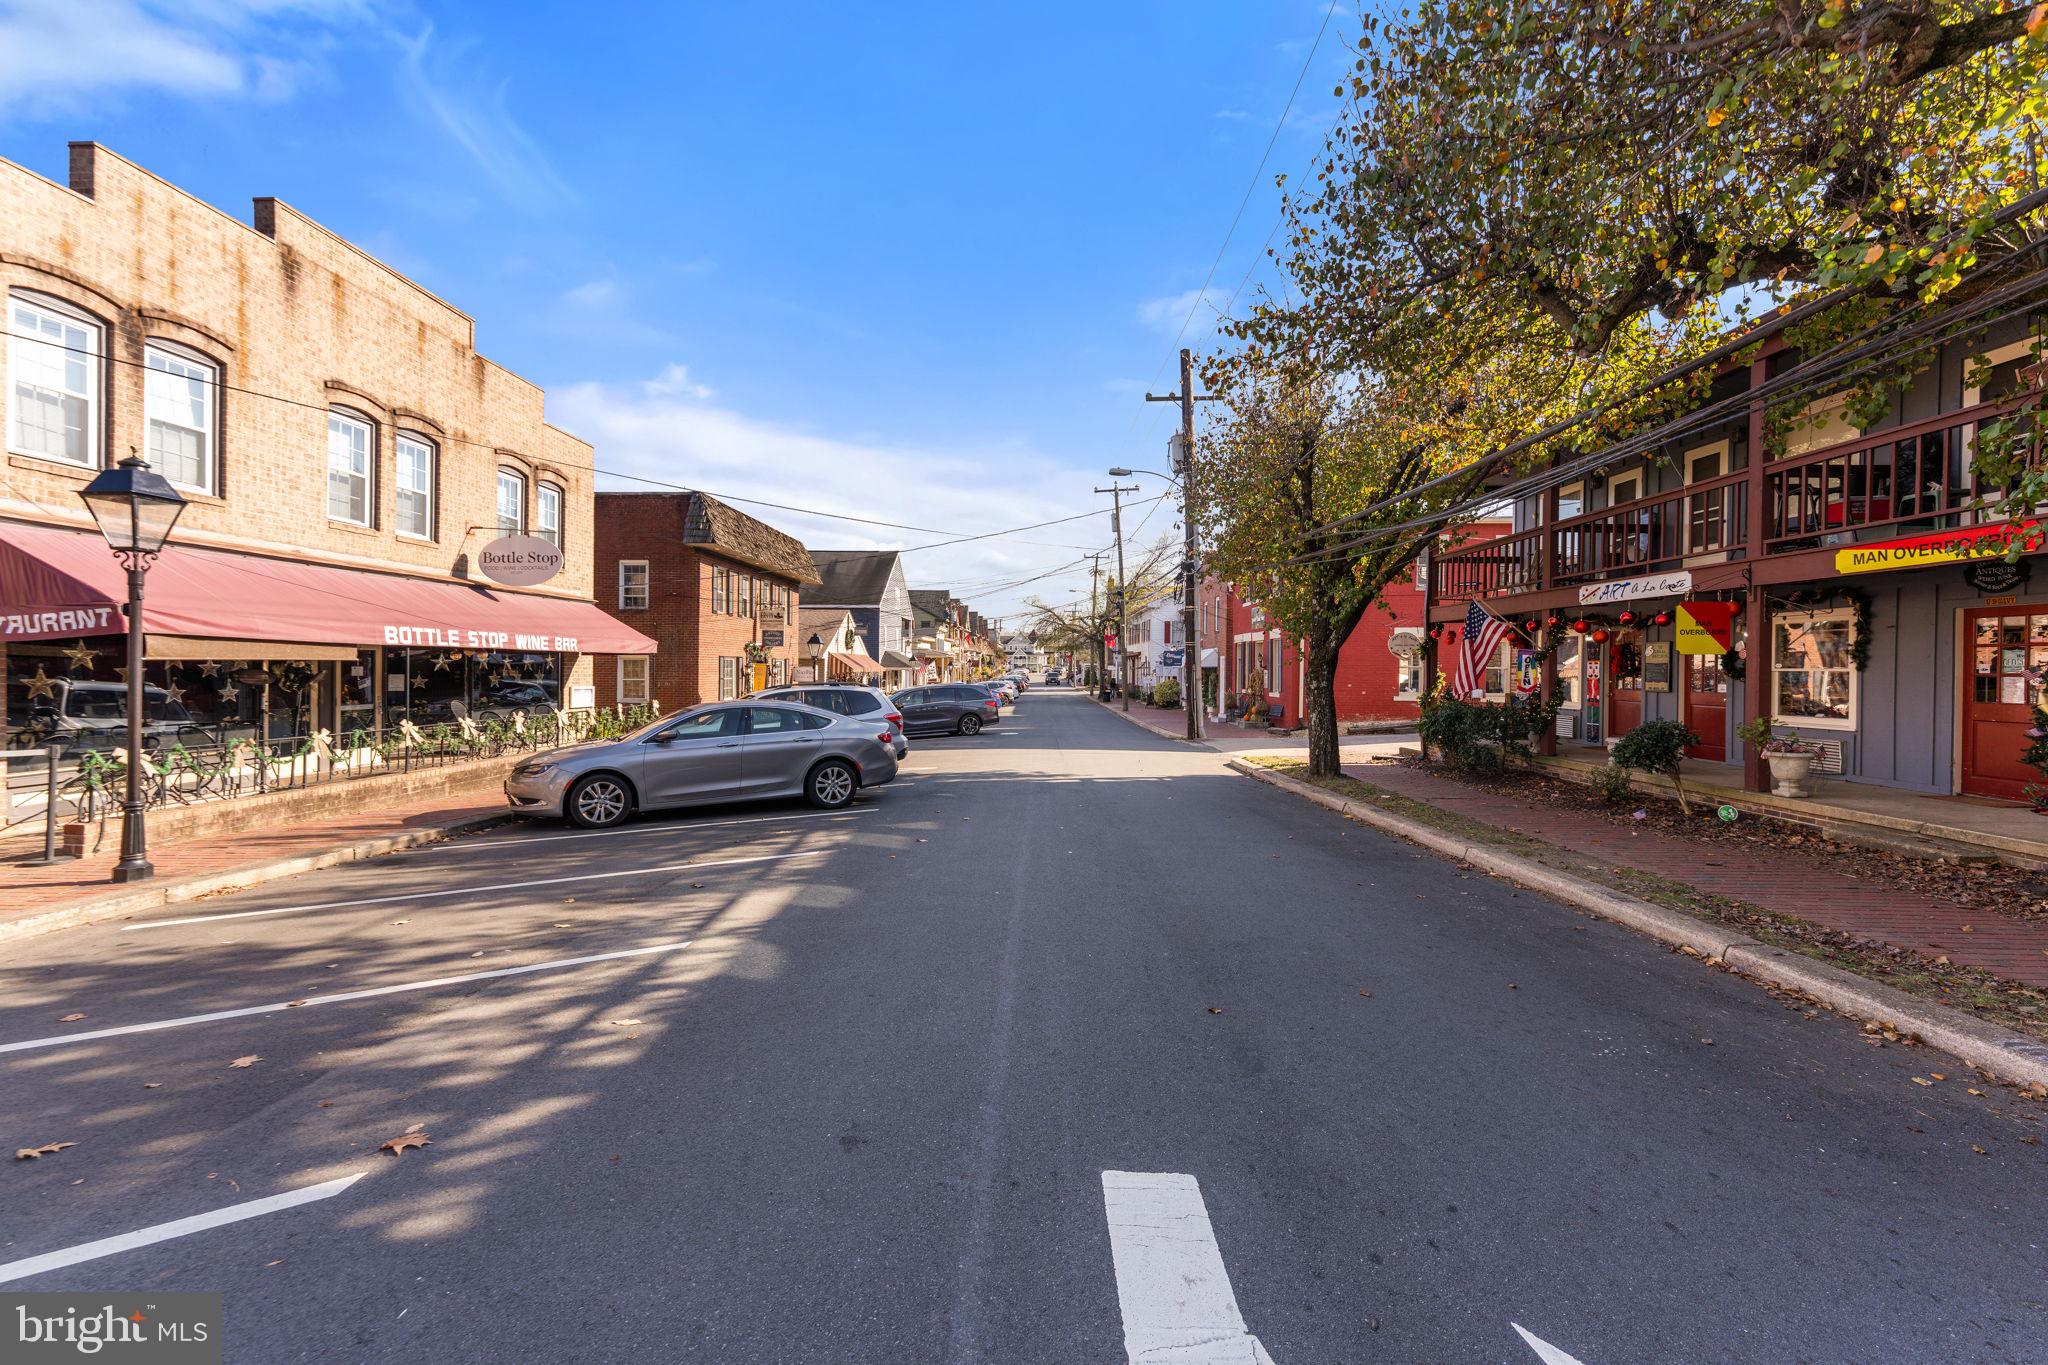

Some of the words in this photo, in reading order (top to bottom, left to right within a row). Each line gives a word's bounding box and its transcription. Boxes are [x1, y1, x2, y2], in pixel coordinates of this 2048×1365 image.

[483, 551, 524, 564] Bottle
[528, 551, 559, 566] Stop
[1853, 549, 1888, 565] MAN
[1976, 565, 2017, 575] ANTIQUES
[1600, 582, 1631, 600] ART
[1641, 580, 1656, 593] La
[384, 625, 460, 647] BOTTLE
[467, 630, 509, 648] STOP
[515, 634, 549, 651] WINE
[554, 637, 578, 652] BAR
[1523, 656, 1531, 686] OPEN
